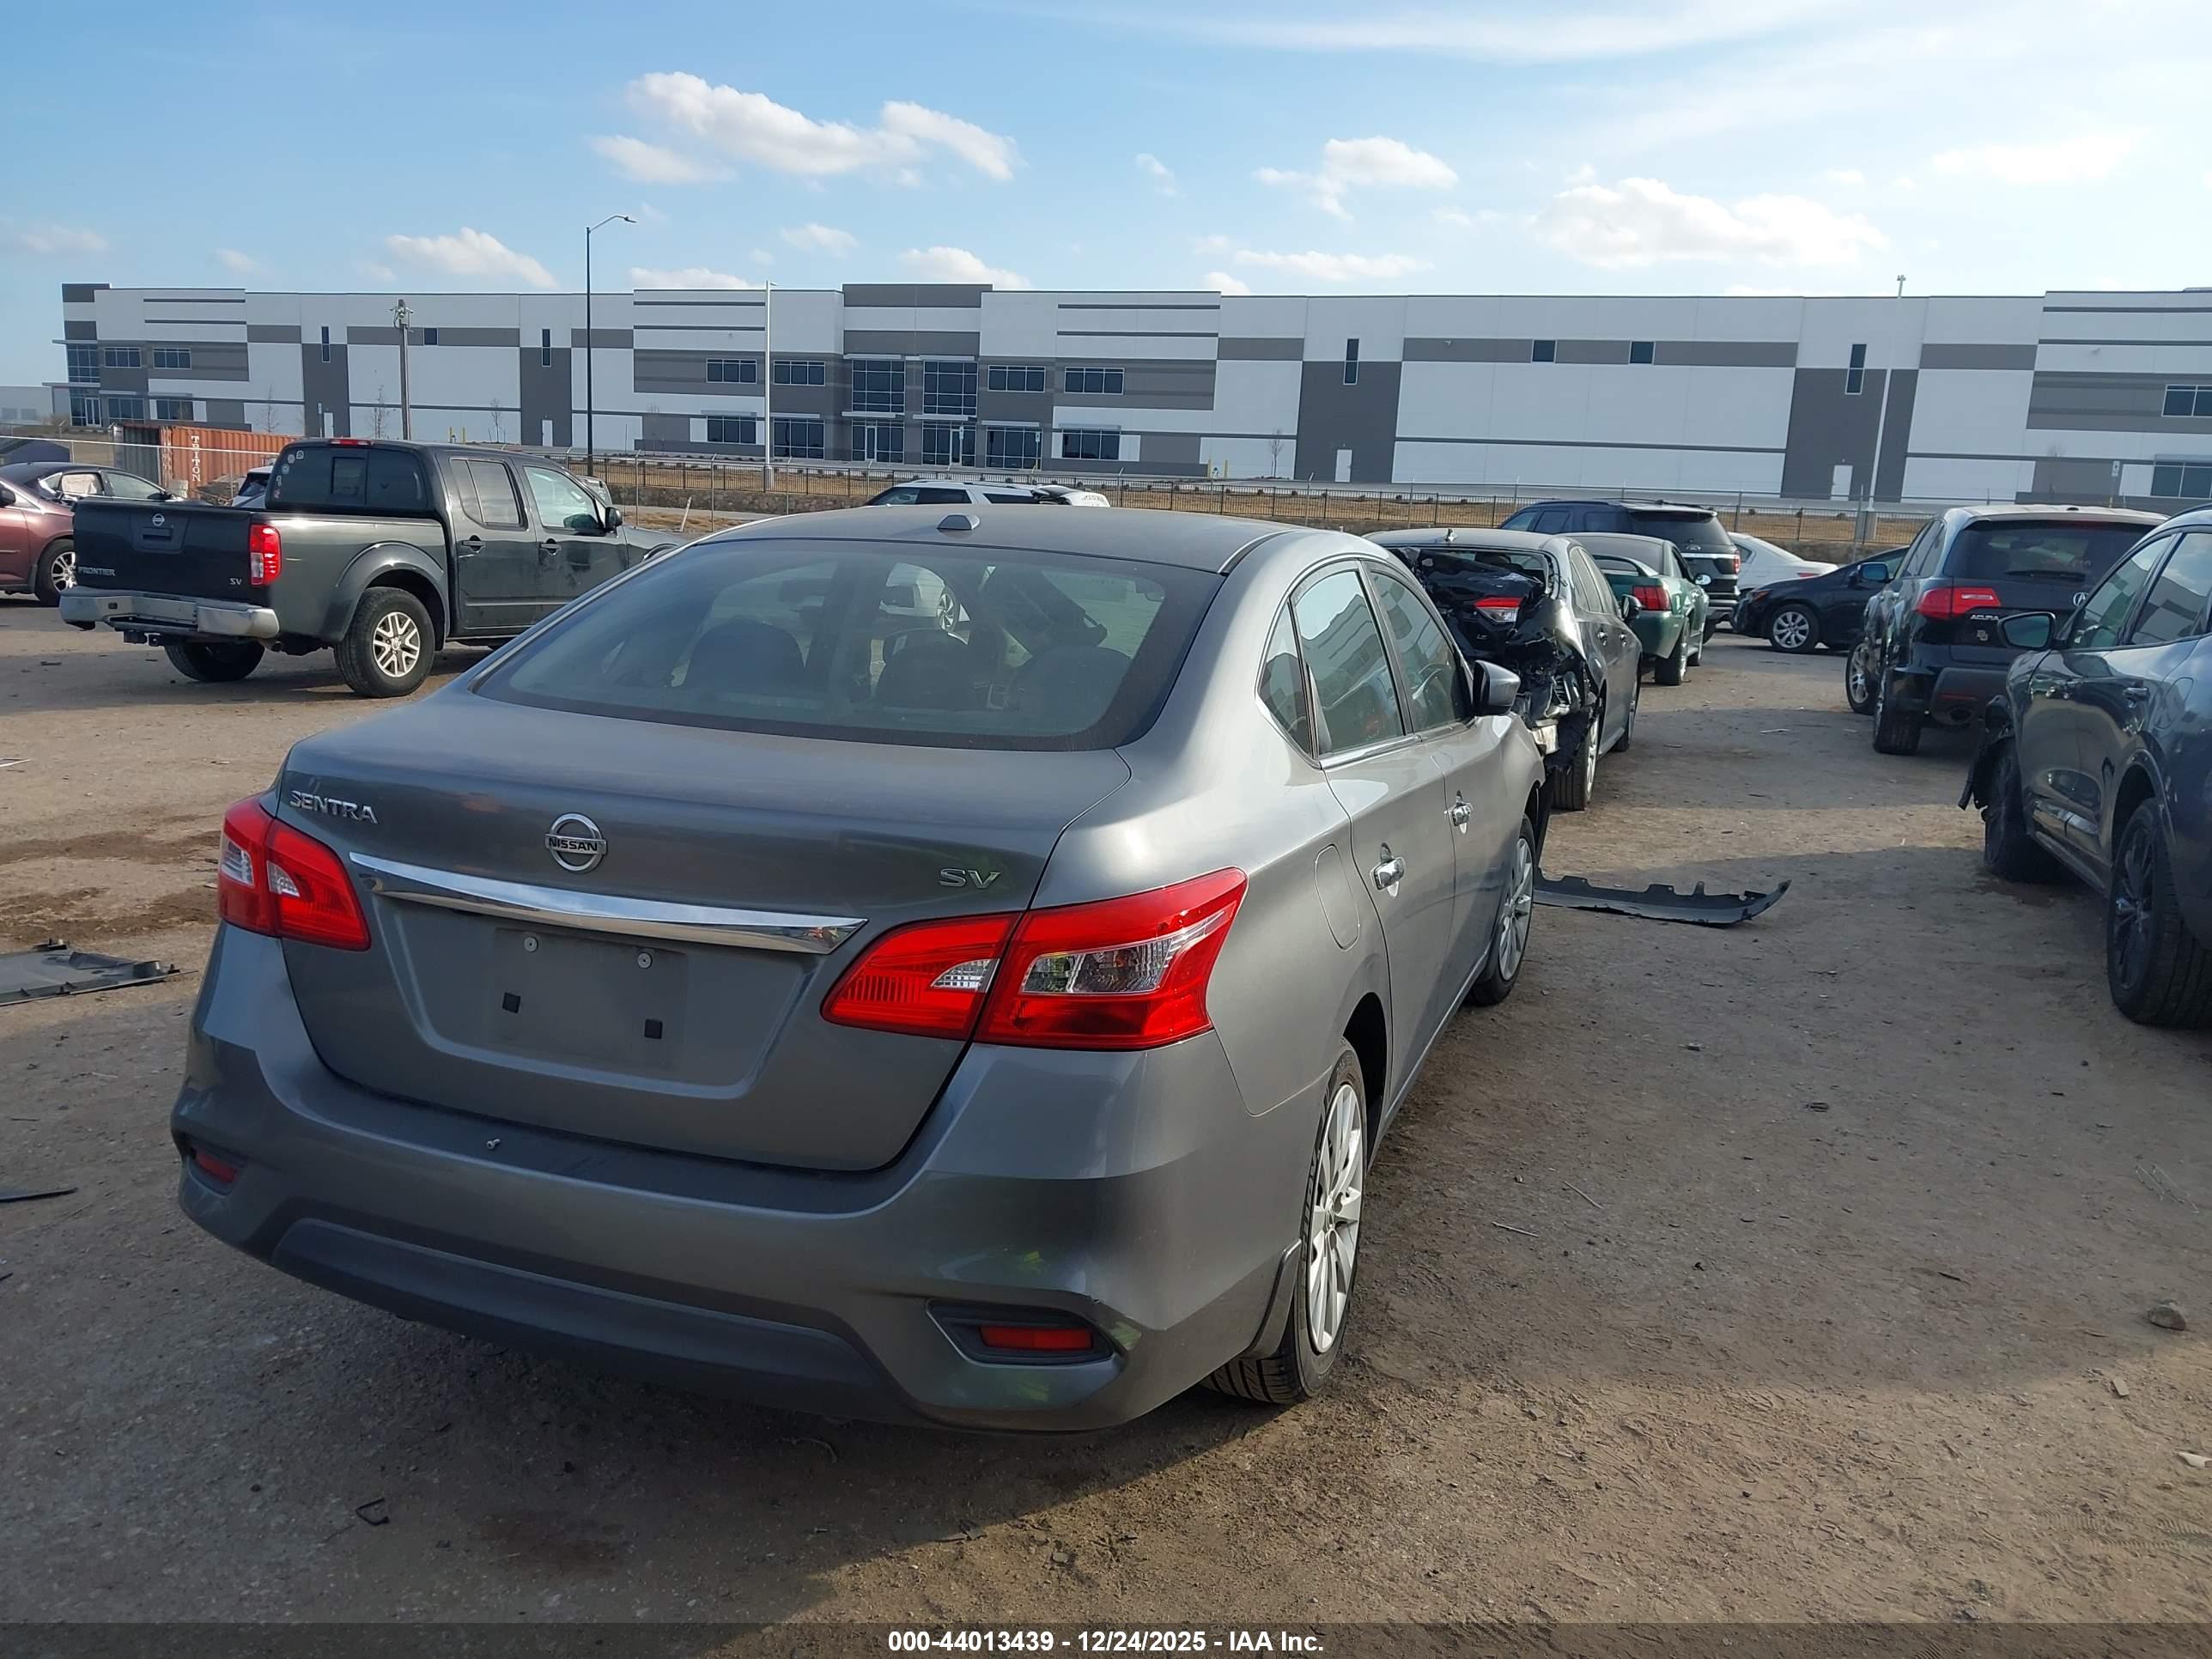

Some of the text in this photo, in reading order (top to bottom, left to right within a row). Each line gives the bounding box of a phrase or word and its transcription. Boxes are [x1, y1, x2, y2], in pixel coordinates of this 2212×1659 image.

[191, 435, 201, 482] TRITON
[78, 566, 116, 576] FRONTIER
[229, 577, 242, 586] SV
[289, 790, 379, 824] SENTRA
[549, 837, 598, 852] NISSAN
[939, 868, 1002, 889] SV
